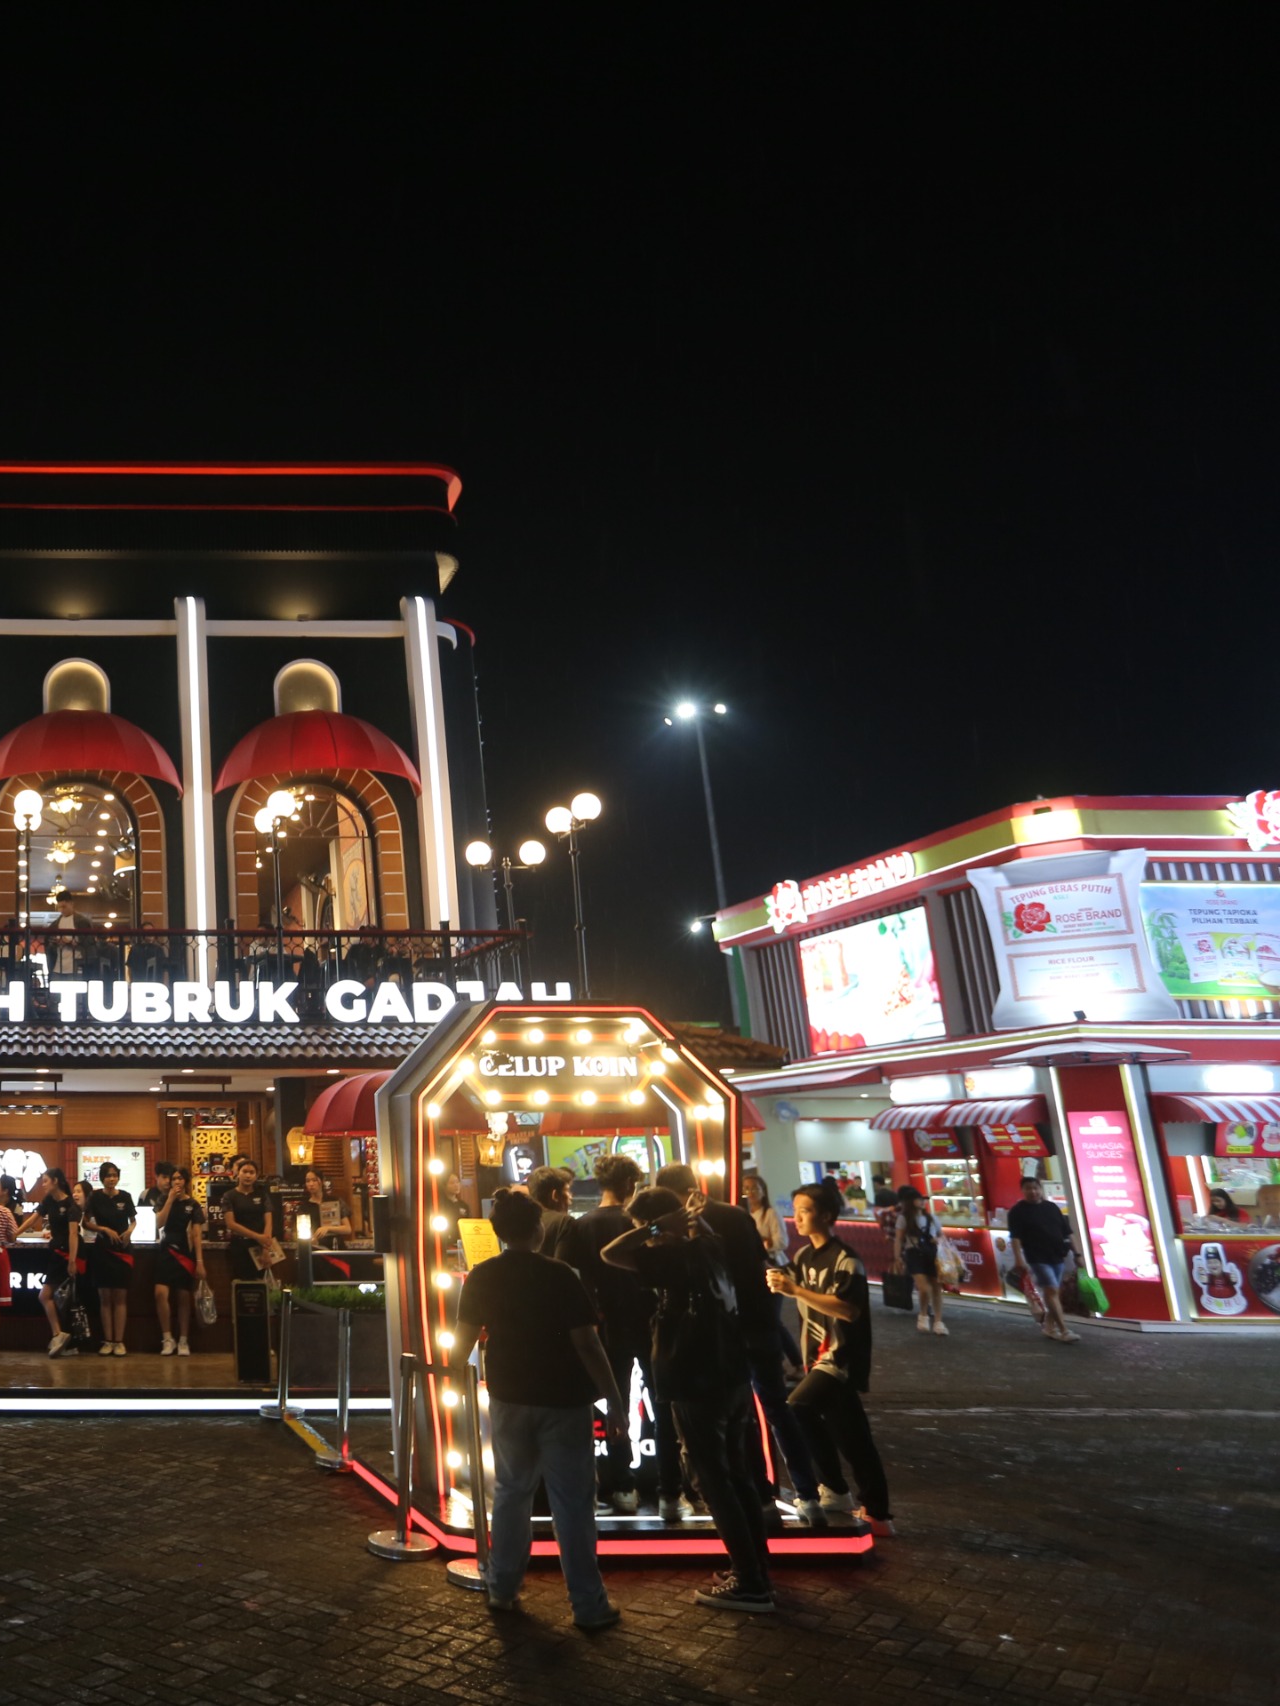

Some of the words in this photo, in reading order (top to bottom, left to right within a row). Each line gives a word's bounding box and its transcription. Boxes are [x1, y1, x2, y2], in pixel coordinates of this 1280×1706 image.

[1010, 887, 1047, 904] TEPUNG
[1048, 883, 1079, 894] BERAS
[1081, 884, 1113, 895] PUTIH
[1055, 912, 1083, 924] ROSE
[1086, 908, 1122, 921] BRAND
[1188, 908, 1221, 916] TEPUNG
[1222, 908, 1258, 916] TAPIOKA
[1068, 956, 1095, 964] FLOUR
[50, 981, 300, 1022] TUBRUK
[573, 1056, 638, 1077] KOIN
[1082, 1142, 1124, 1150] RAHASIA
[1086, 1151, 1123, 1159] SUKSES
